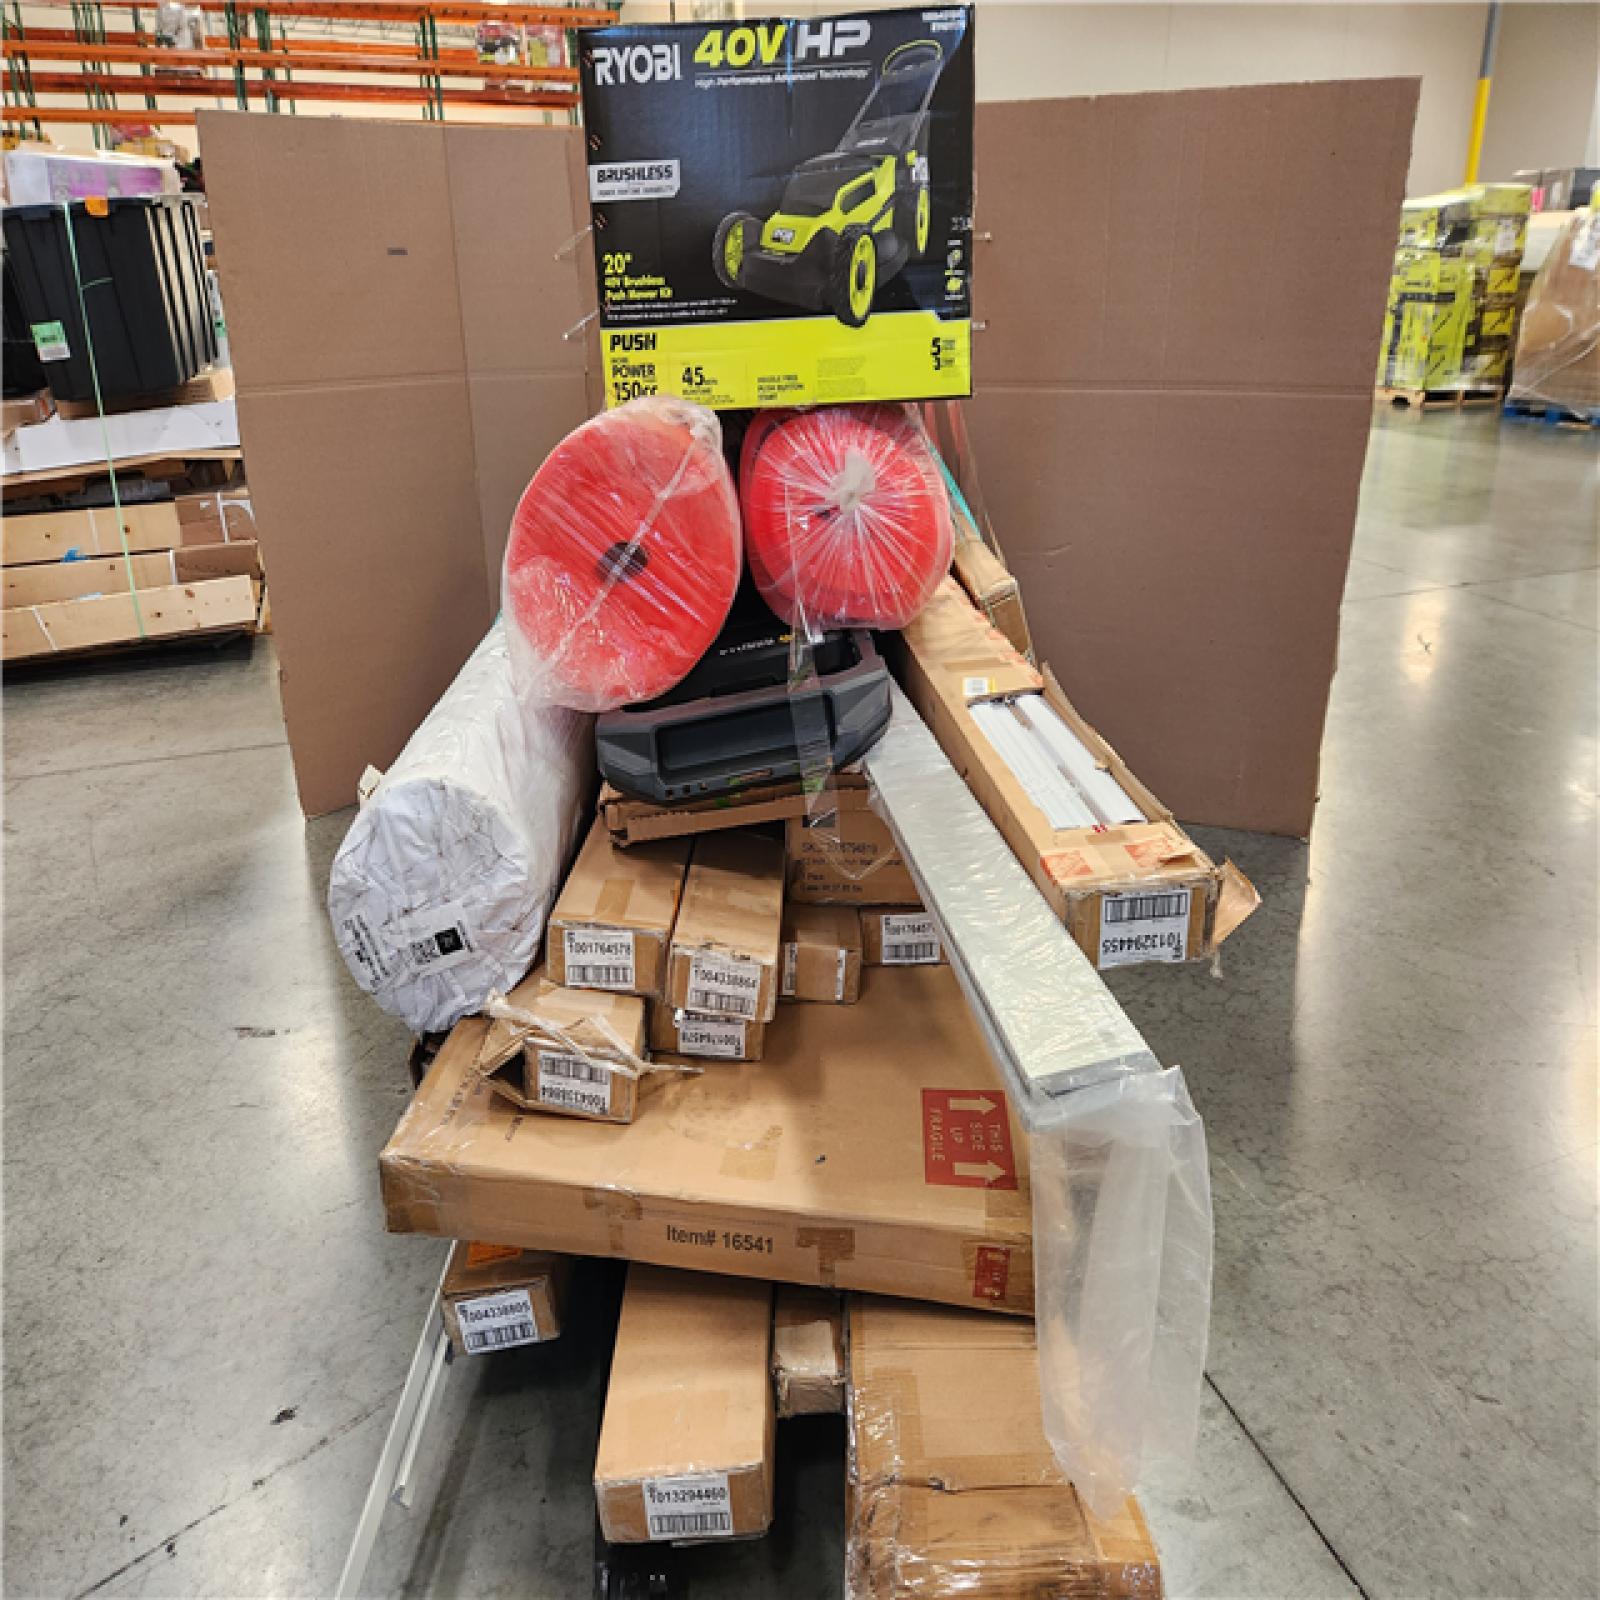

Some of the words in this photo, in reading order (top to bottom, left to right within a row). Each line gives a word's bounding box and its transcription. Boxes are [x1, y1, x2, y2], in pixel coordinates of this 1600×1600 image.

[693, 24, 786, 69] 40V
[797, 19, 872, 59] HP
[593, 43, 682, 86] RYOBI
[596, 164, 674, 184] BRUSHLESS
[609, 332, 657, 353] PUSH
[611, 362, 657, 379] POWER
[682, 366, 705, 387] 45
[929, 1108, 945, 1162] FRAGILE
[950, 1126, 964, 1144] UP
[969, 1121, 986, 1151] SIDE
[989, 1124, 1004, 1152] THIS
[666, 1224, 716, 1246] Item#
[722, 1231, 774, 1255] 16541
